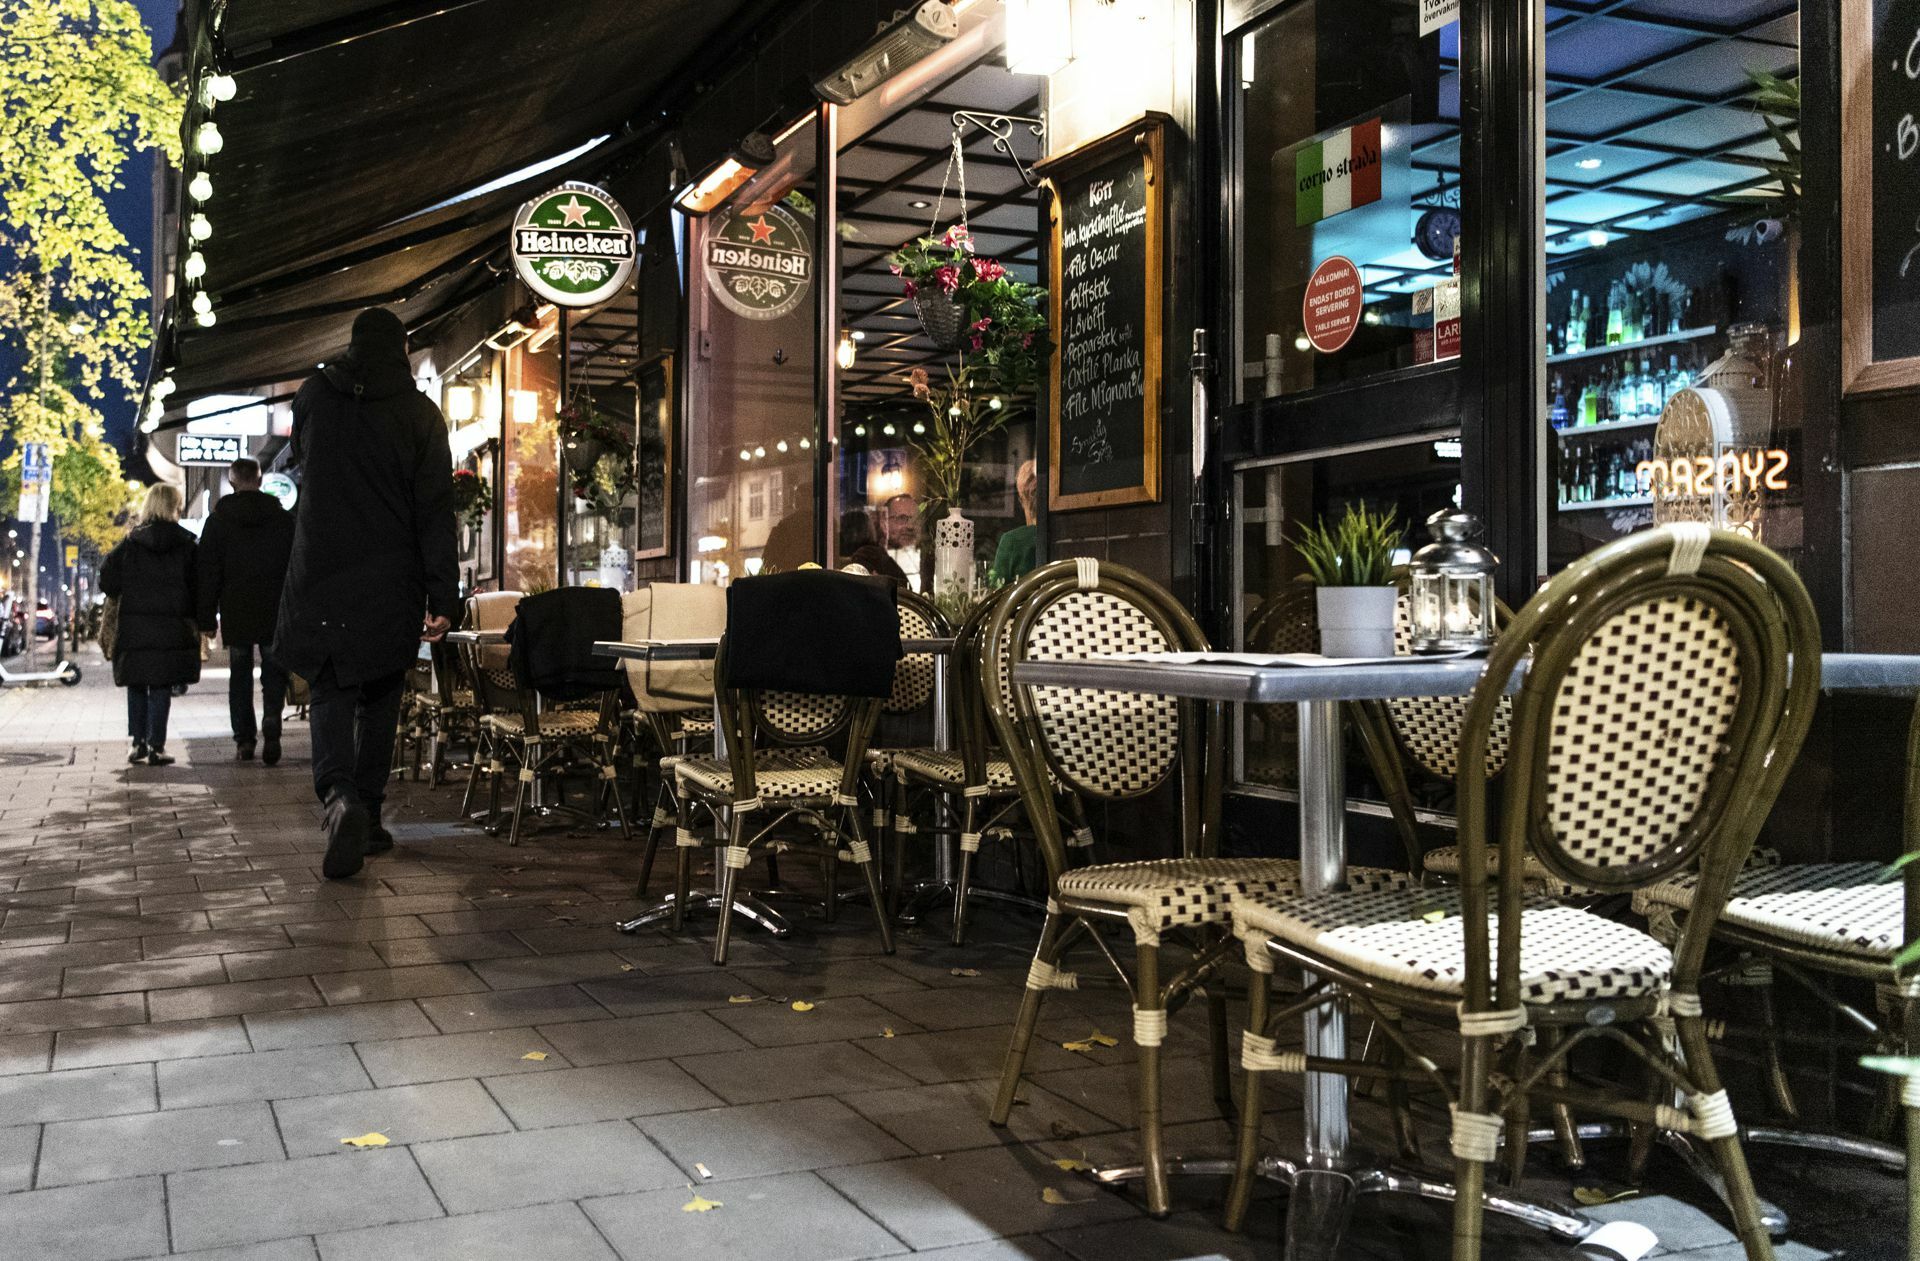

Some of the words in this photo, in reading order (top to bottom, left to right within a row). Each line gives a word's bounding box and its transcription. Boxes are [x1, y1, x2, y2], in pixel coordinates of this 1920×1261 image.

[1299, 166, 1333, 192] corno
[1336, 146, 1377, 180] strada
[520, 231, 627, 255] Heineken
[1090, 243, 1120, 270] Oscar
[1309, 291, 1333, 308] ENDAST
[1334, 285, 1355, 299] BORDS
[1315, 298, 1349, 317] SERVERING
[1315, 321, 1330, 332] TABLE
[1330, 315, 1350, 328] SERVICE
[1438, 321, 1461, 340] LAR
[1102, 346, 1140, 380] Planka
[1091, 380, 1132, 416] Mignon
